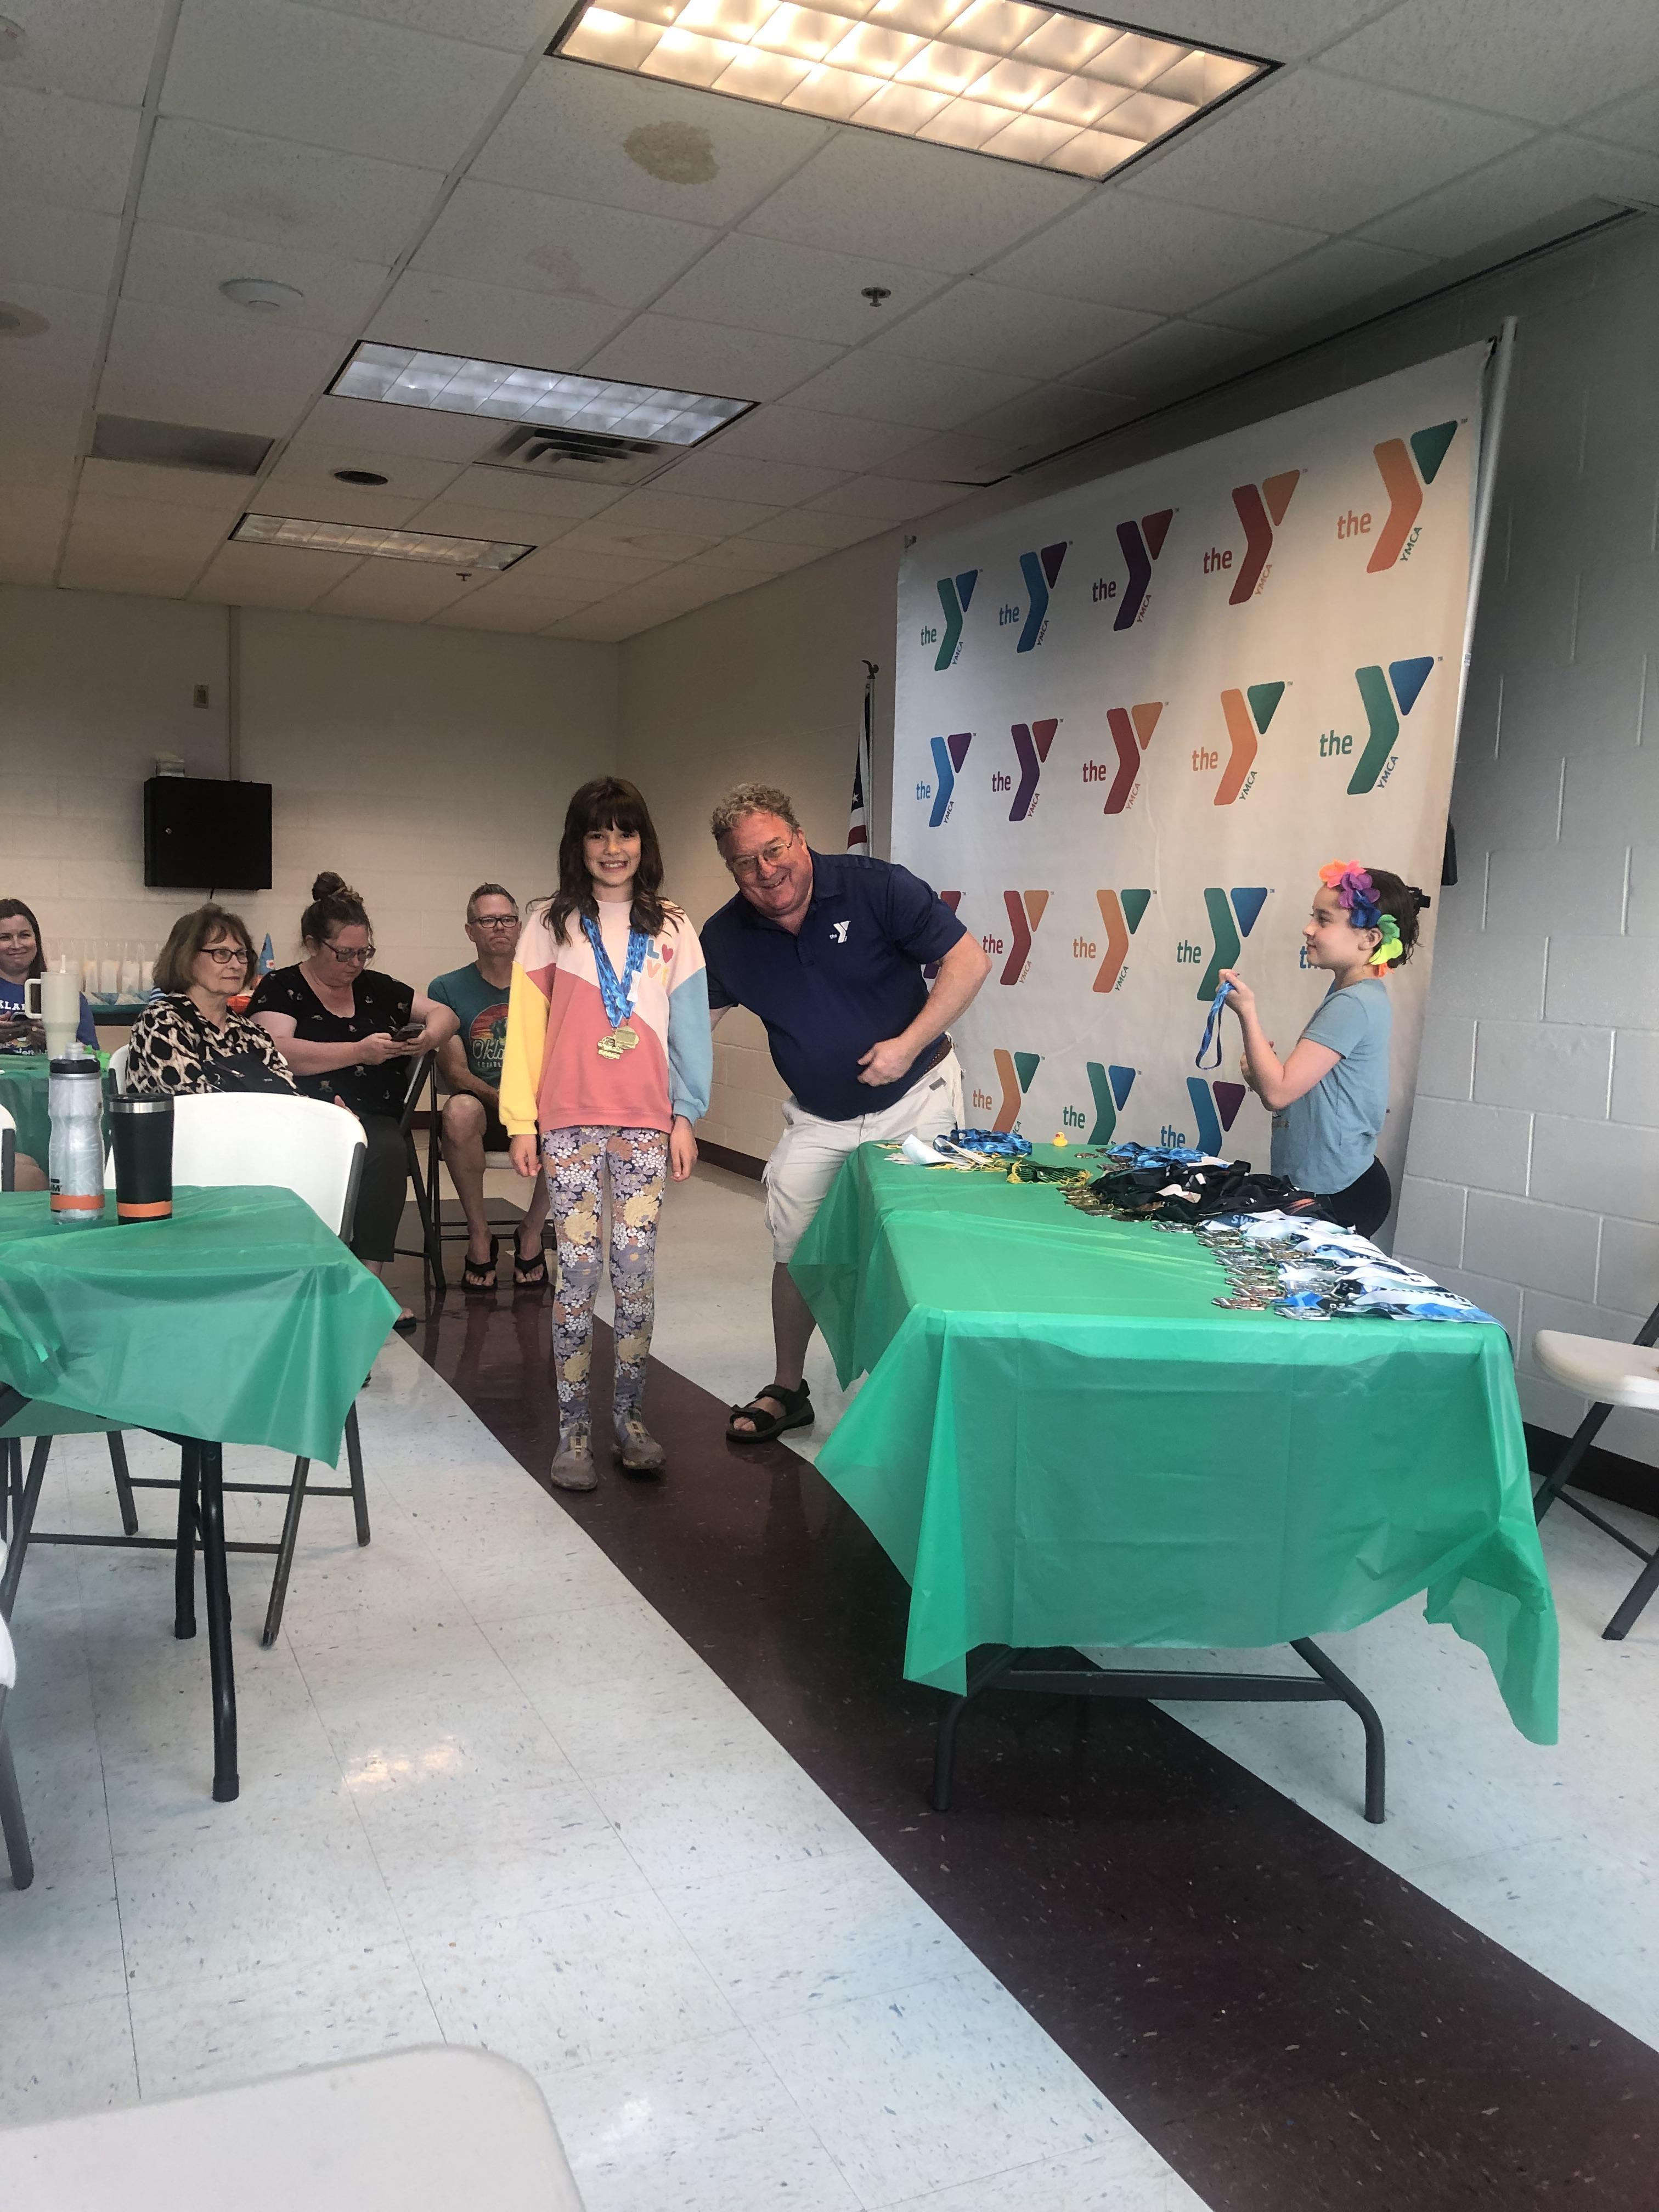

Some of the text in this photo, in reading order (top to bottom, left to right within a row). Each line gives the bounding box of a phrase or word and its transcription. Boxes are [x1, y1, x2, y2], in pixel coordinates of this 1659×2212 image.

[1337, 510, 1372, 540] the
[1400, 526, 1423, 562] YMCA
[1203, 547, 1233, 574] the
[1092, 578, 1117, 603] the
[1255, 563, 1273, 596] YMCA
[999, 605, 1020, 627] the
[1136, 594, 1152, 623] YMCA
[920, 626, 937, 646] the
[1036, 619, 1049, 646] YMCA
[952, 641, 964, 665] YMCA
[1319, 730, 1353, 758] the
[1082, 759, 1107, 783] the
[1192, 747, 1218, 772] the
[1376, 755, 1399, 789] YMCA
[916, 781, 931, 800] the
[992, 771, 1011, 792] the
[1239, 770, 1258, 800] YMCA
[1027, 792, 1041, 819] YMCA
[1125, 782, 1141, 811] YMCA
[943, 800, 955, 825] YMCA
[983, 934, 1003, 954] the
[1073, 936, 1096, 959] the
[1177, 940, 1201, 964] the
[1019, 960, 1032, 984] YMCA
[1114, 965, 1130, 992] YMCA
[972, 1089, 992, 1111] the
[1063, 1105, 1086, 1129] the
[1161, 1124, 1186, 1148] the
